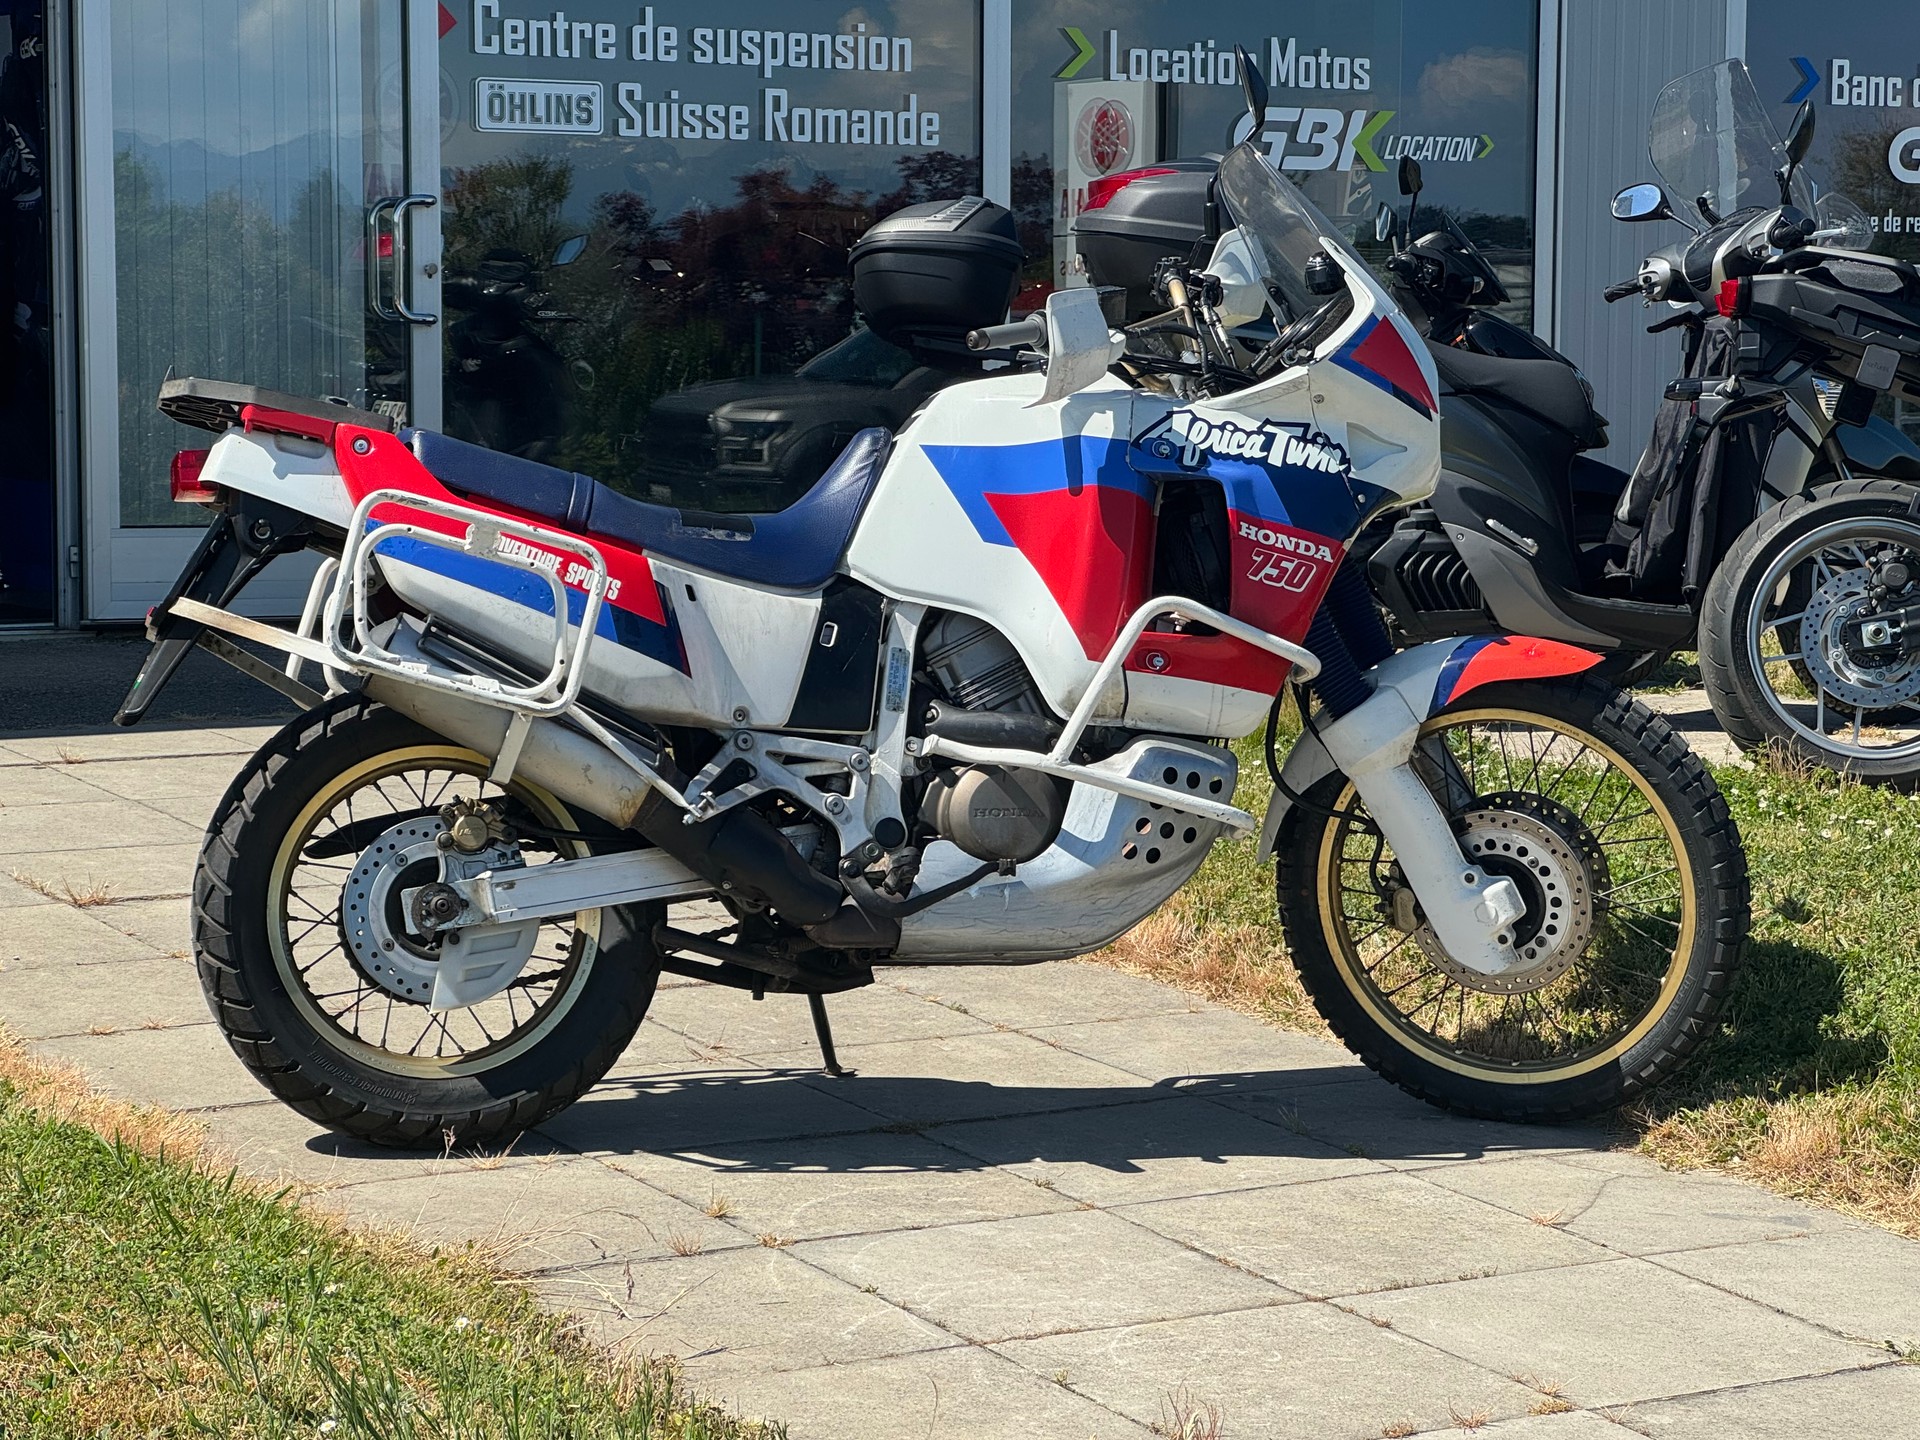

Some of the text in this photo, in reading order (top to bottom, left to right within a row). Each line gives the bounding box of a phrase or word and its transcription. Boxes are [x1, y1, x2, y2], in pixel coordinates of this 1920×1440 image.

[474, 0, 912, 79] Centre de suspension
[1270, 36, 1371, 91] Motos
[486, 83, 595, 126] ÖHLINS
[1831, 58, 1903, 107] Banc
[618, 82, 940, 146] Suisse Romande
[1233, 106, 1478, 172] GBK LOCATION
[1883, 209, 1902, 232] de
[1131, 408, 1351, 475] Africa Twin
[498, 535, 622, 601] VENTURE SPOTS
[1238, 521, 1334, 563] HONDA
[1246, 547, 1316, 593] 750
[973, 807, 1046, 819] HONDA
